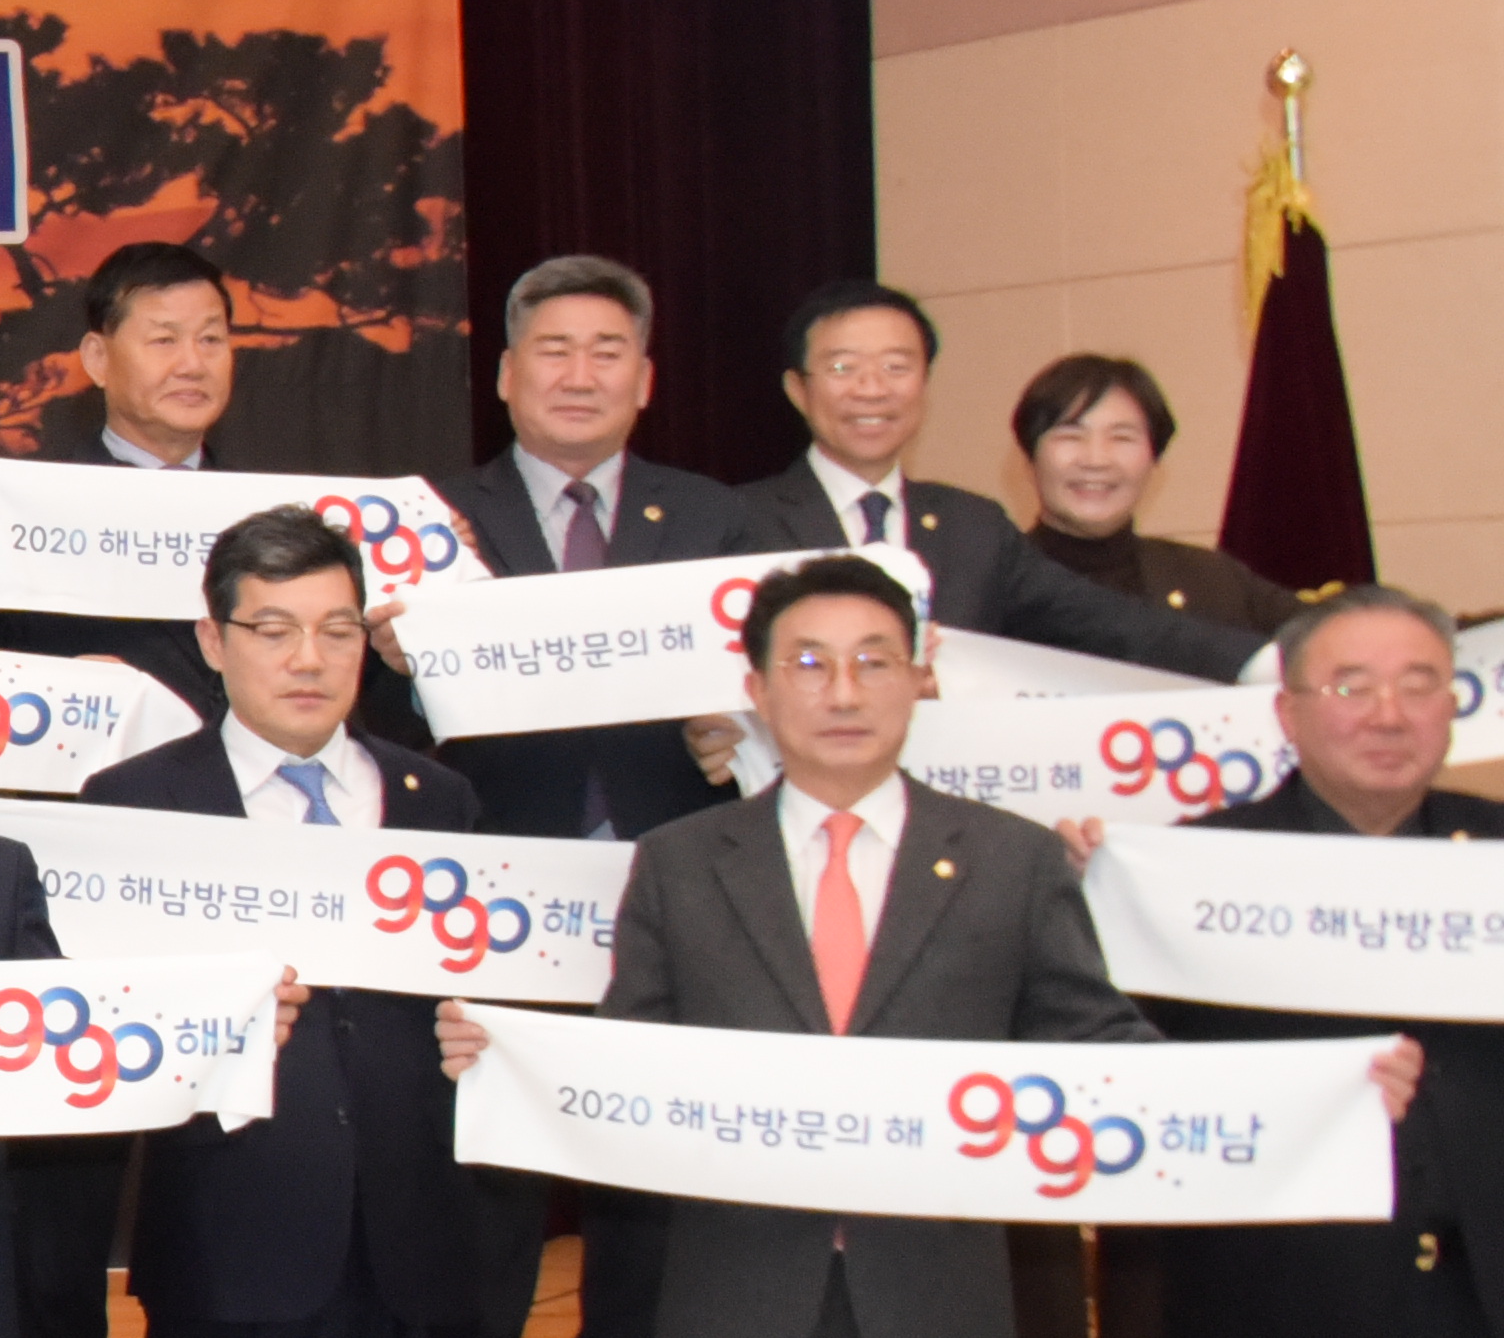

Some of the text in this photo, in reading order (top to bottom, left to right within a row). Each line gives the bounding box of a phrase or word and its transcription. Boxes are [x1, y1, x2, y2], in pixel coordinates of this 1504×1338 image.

[11, 524, 87, 555] 2020
[472, 628, 648, 676] 해남방문의
[659, 623, 694, 651] 해
[1049, 763, 1081, 790] 해
[42, 869, 105, 902] 020
[119, 874, 298, 923] 해남방문의
[311, 892, 344, 922] 해
[1194, 899, 1292, 936] 2020
[557, 1085, 652, 1127] 2020
[667, 1097, 871, 1150] 해남방문의
[884, 1113, 924, 1149] 해
[1159, 1111, 1264, 1165] 해남
